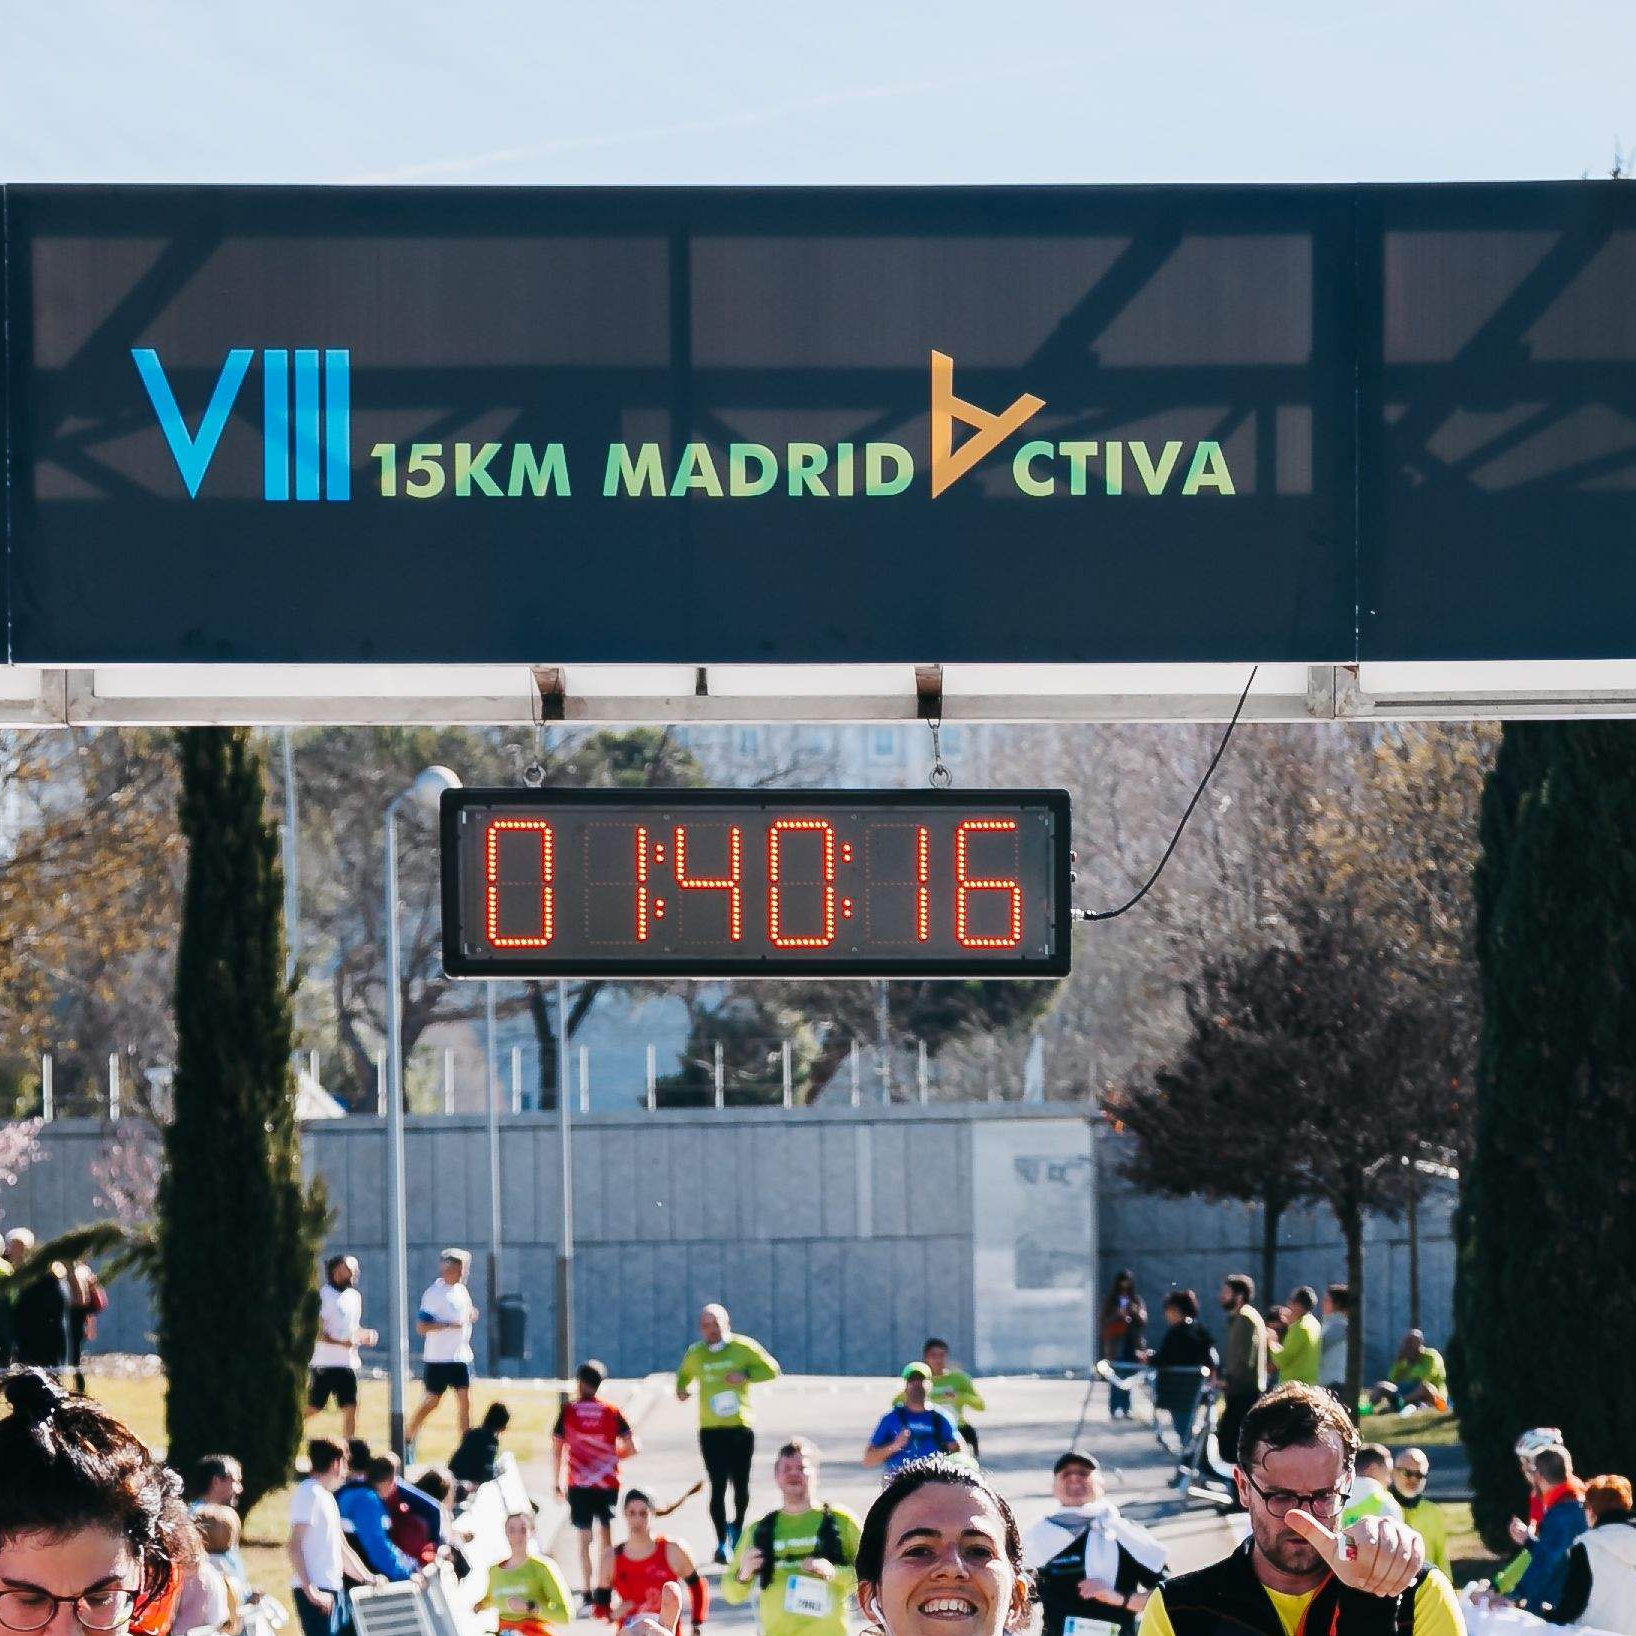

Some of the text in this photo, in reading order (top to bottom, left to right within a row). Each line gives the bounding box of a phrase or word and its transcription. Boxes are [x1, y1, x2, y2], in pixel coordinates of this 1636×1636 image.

[129, 348, 351, 502] VIII
[370, 442, 571, 499] 15KM
[604, 442, 916, 499] MADRID
